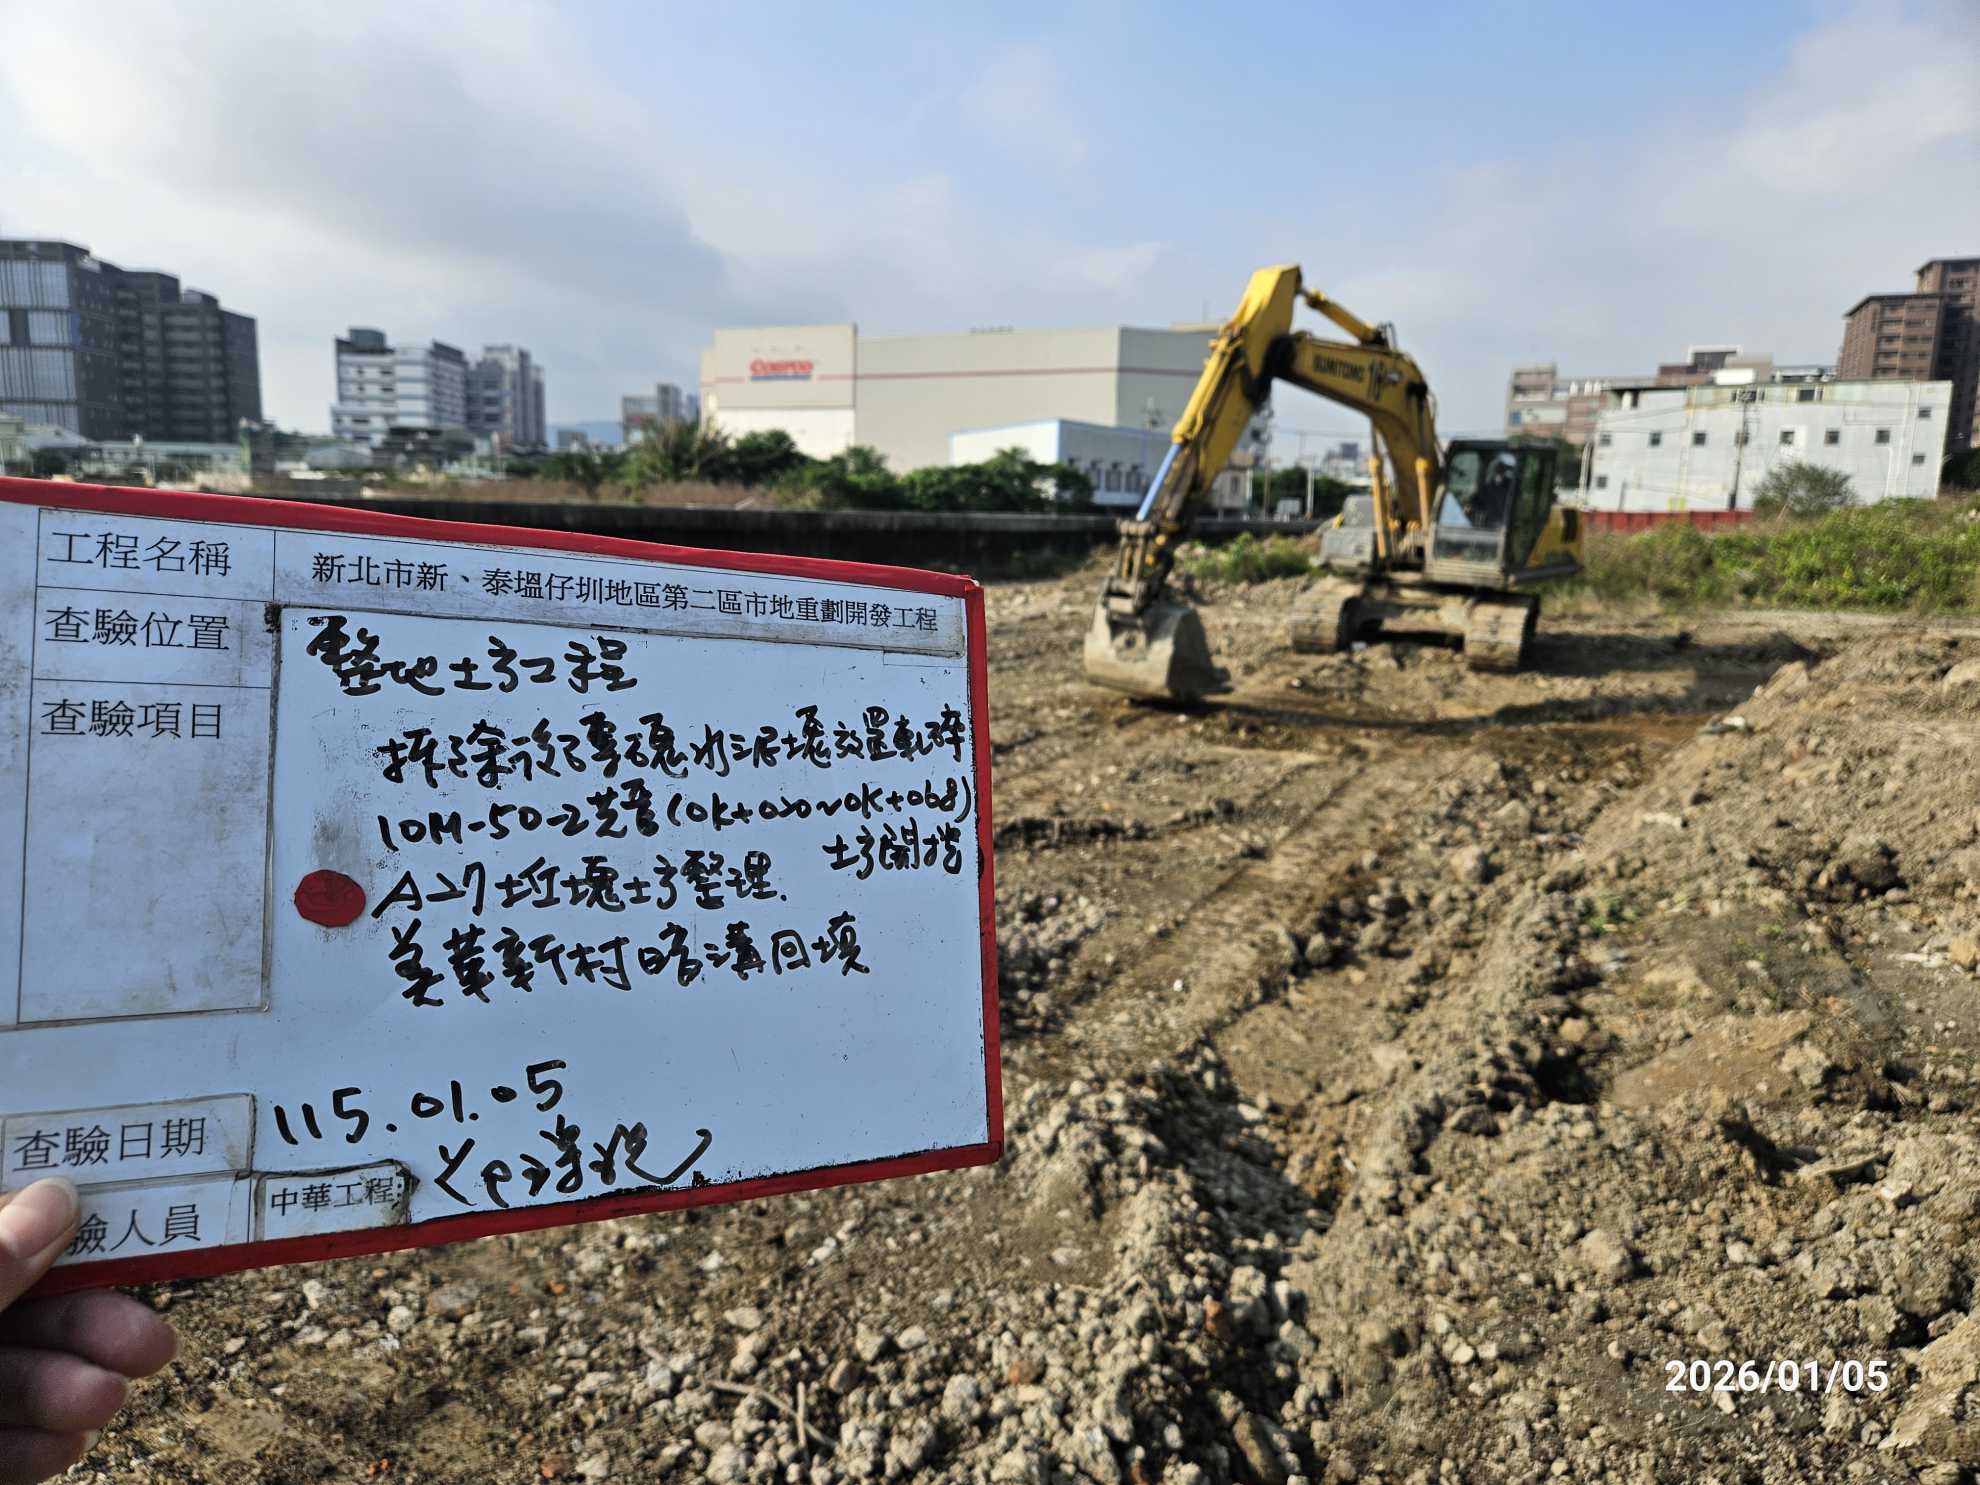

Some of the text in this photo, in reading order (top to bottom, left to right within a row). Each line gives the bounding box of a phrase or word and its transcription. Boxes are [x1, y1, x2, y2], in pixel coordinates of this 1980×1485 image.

[47, 530, 232, 577] 工程名稱
[44, 605, 231, 651] 查驗位置
[41, 698, 223, 740] 查驗項目
[11, 1116, 207, 1172] 查驗日期
[270, 1175, 395, 1218] 中華工程
